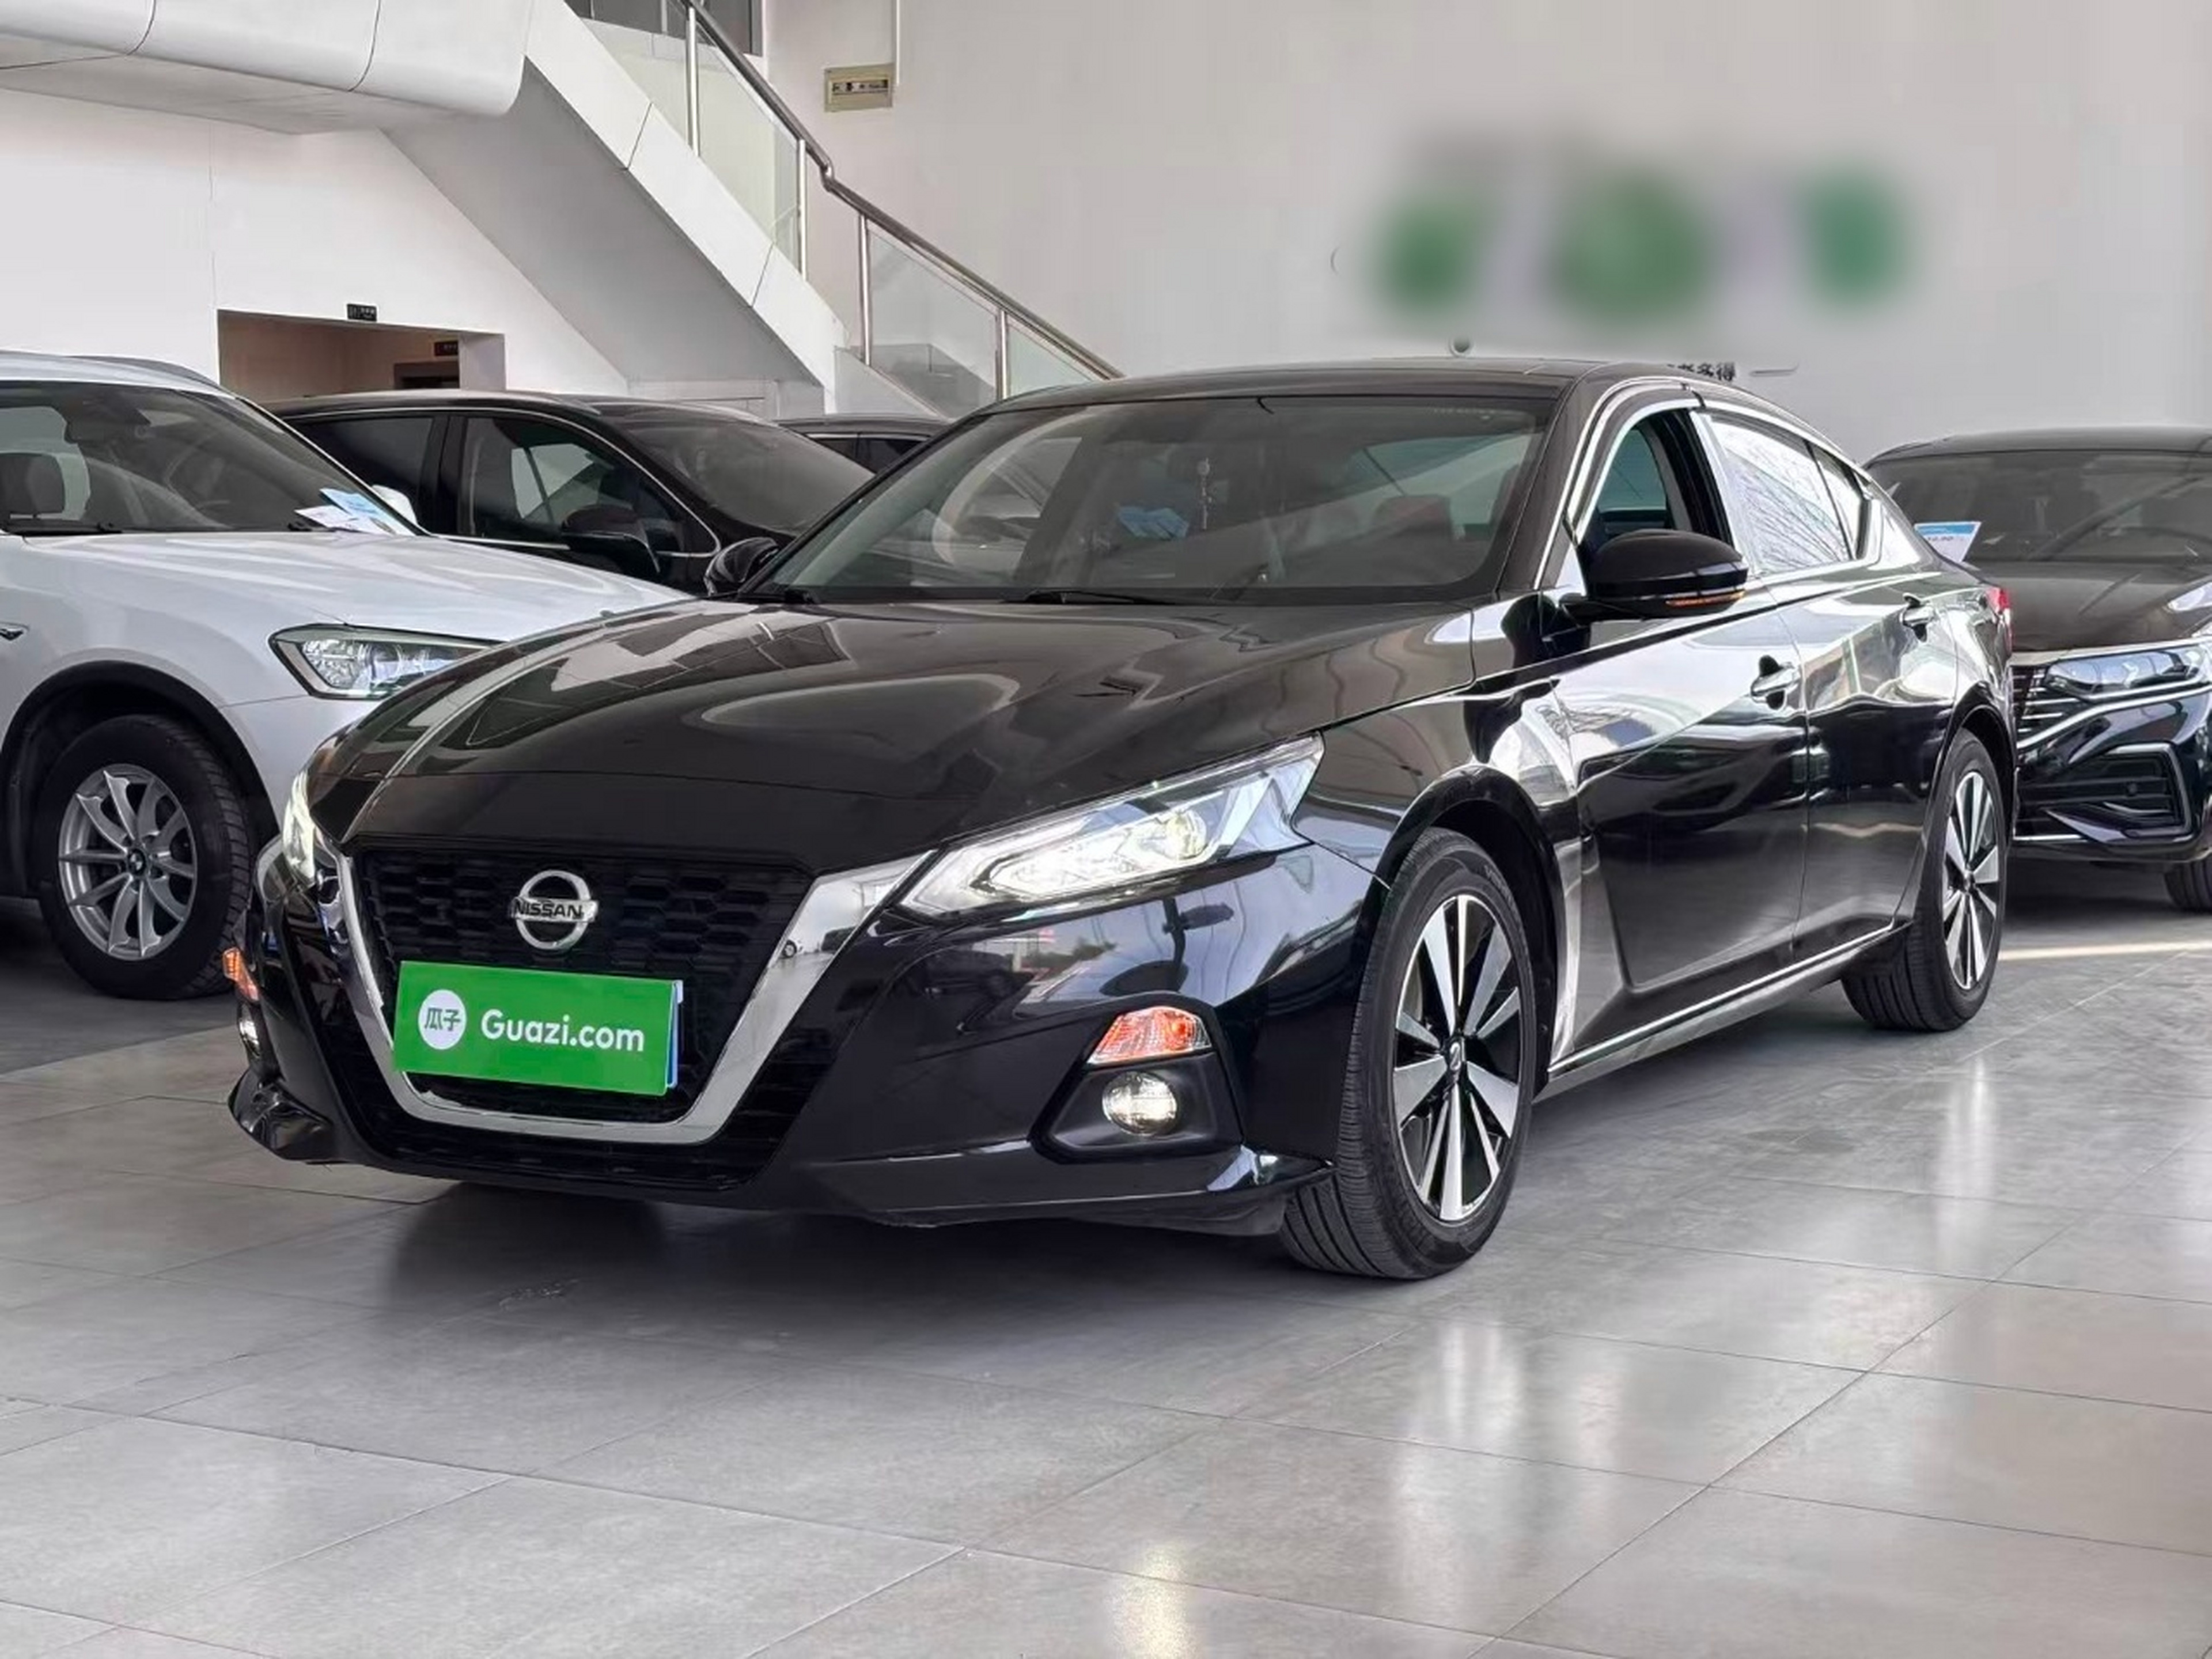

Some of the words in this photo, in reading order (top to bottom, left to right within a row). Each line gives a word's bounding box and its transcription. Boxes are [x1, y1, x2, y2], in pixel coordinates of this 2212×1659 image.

[514, 899, 582, 919] NISSAN
[425, 1007, 460, 1031] 瓜子
[481, 1009, 645, 1051] Guazi.com
